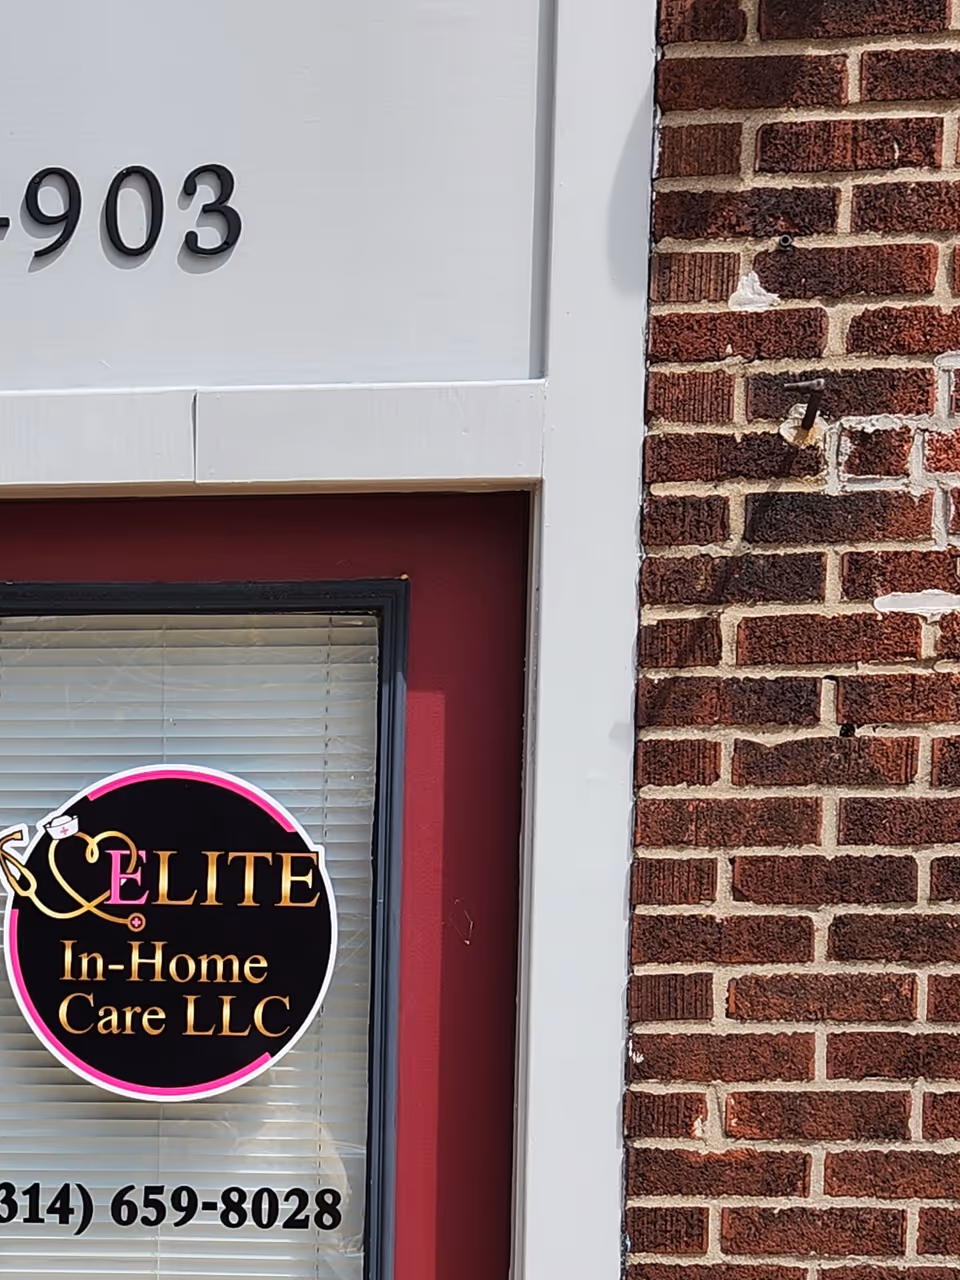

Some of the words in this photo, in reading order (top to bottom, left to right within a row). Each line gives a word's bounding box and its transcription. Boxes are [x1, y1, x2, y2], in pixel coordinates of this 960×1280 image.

[105, 849, 320, 907] ELITE
[59, 940, 268, 984] In-Home
[58, 992, 166, 1035] Care
[182, 994, 290, 1037] LLC
[110, 1184, 342, 1231] 659-8028
